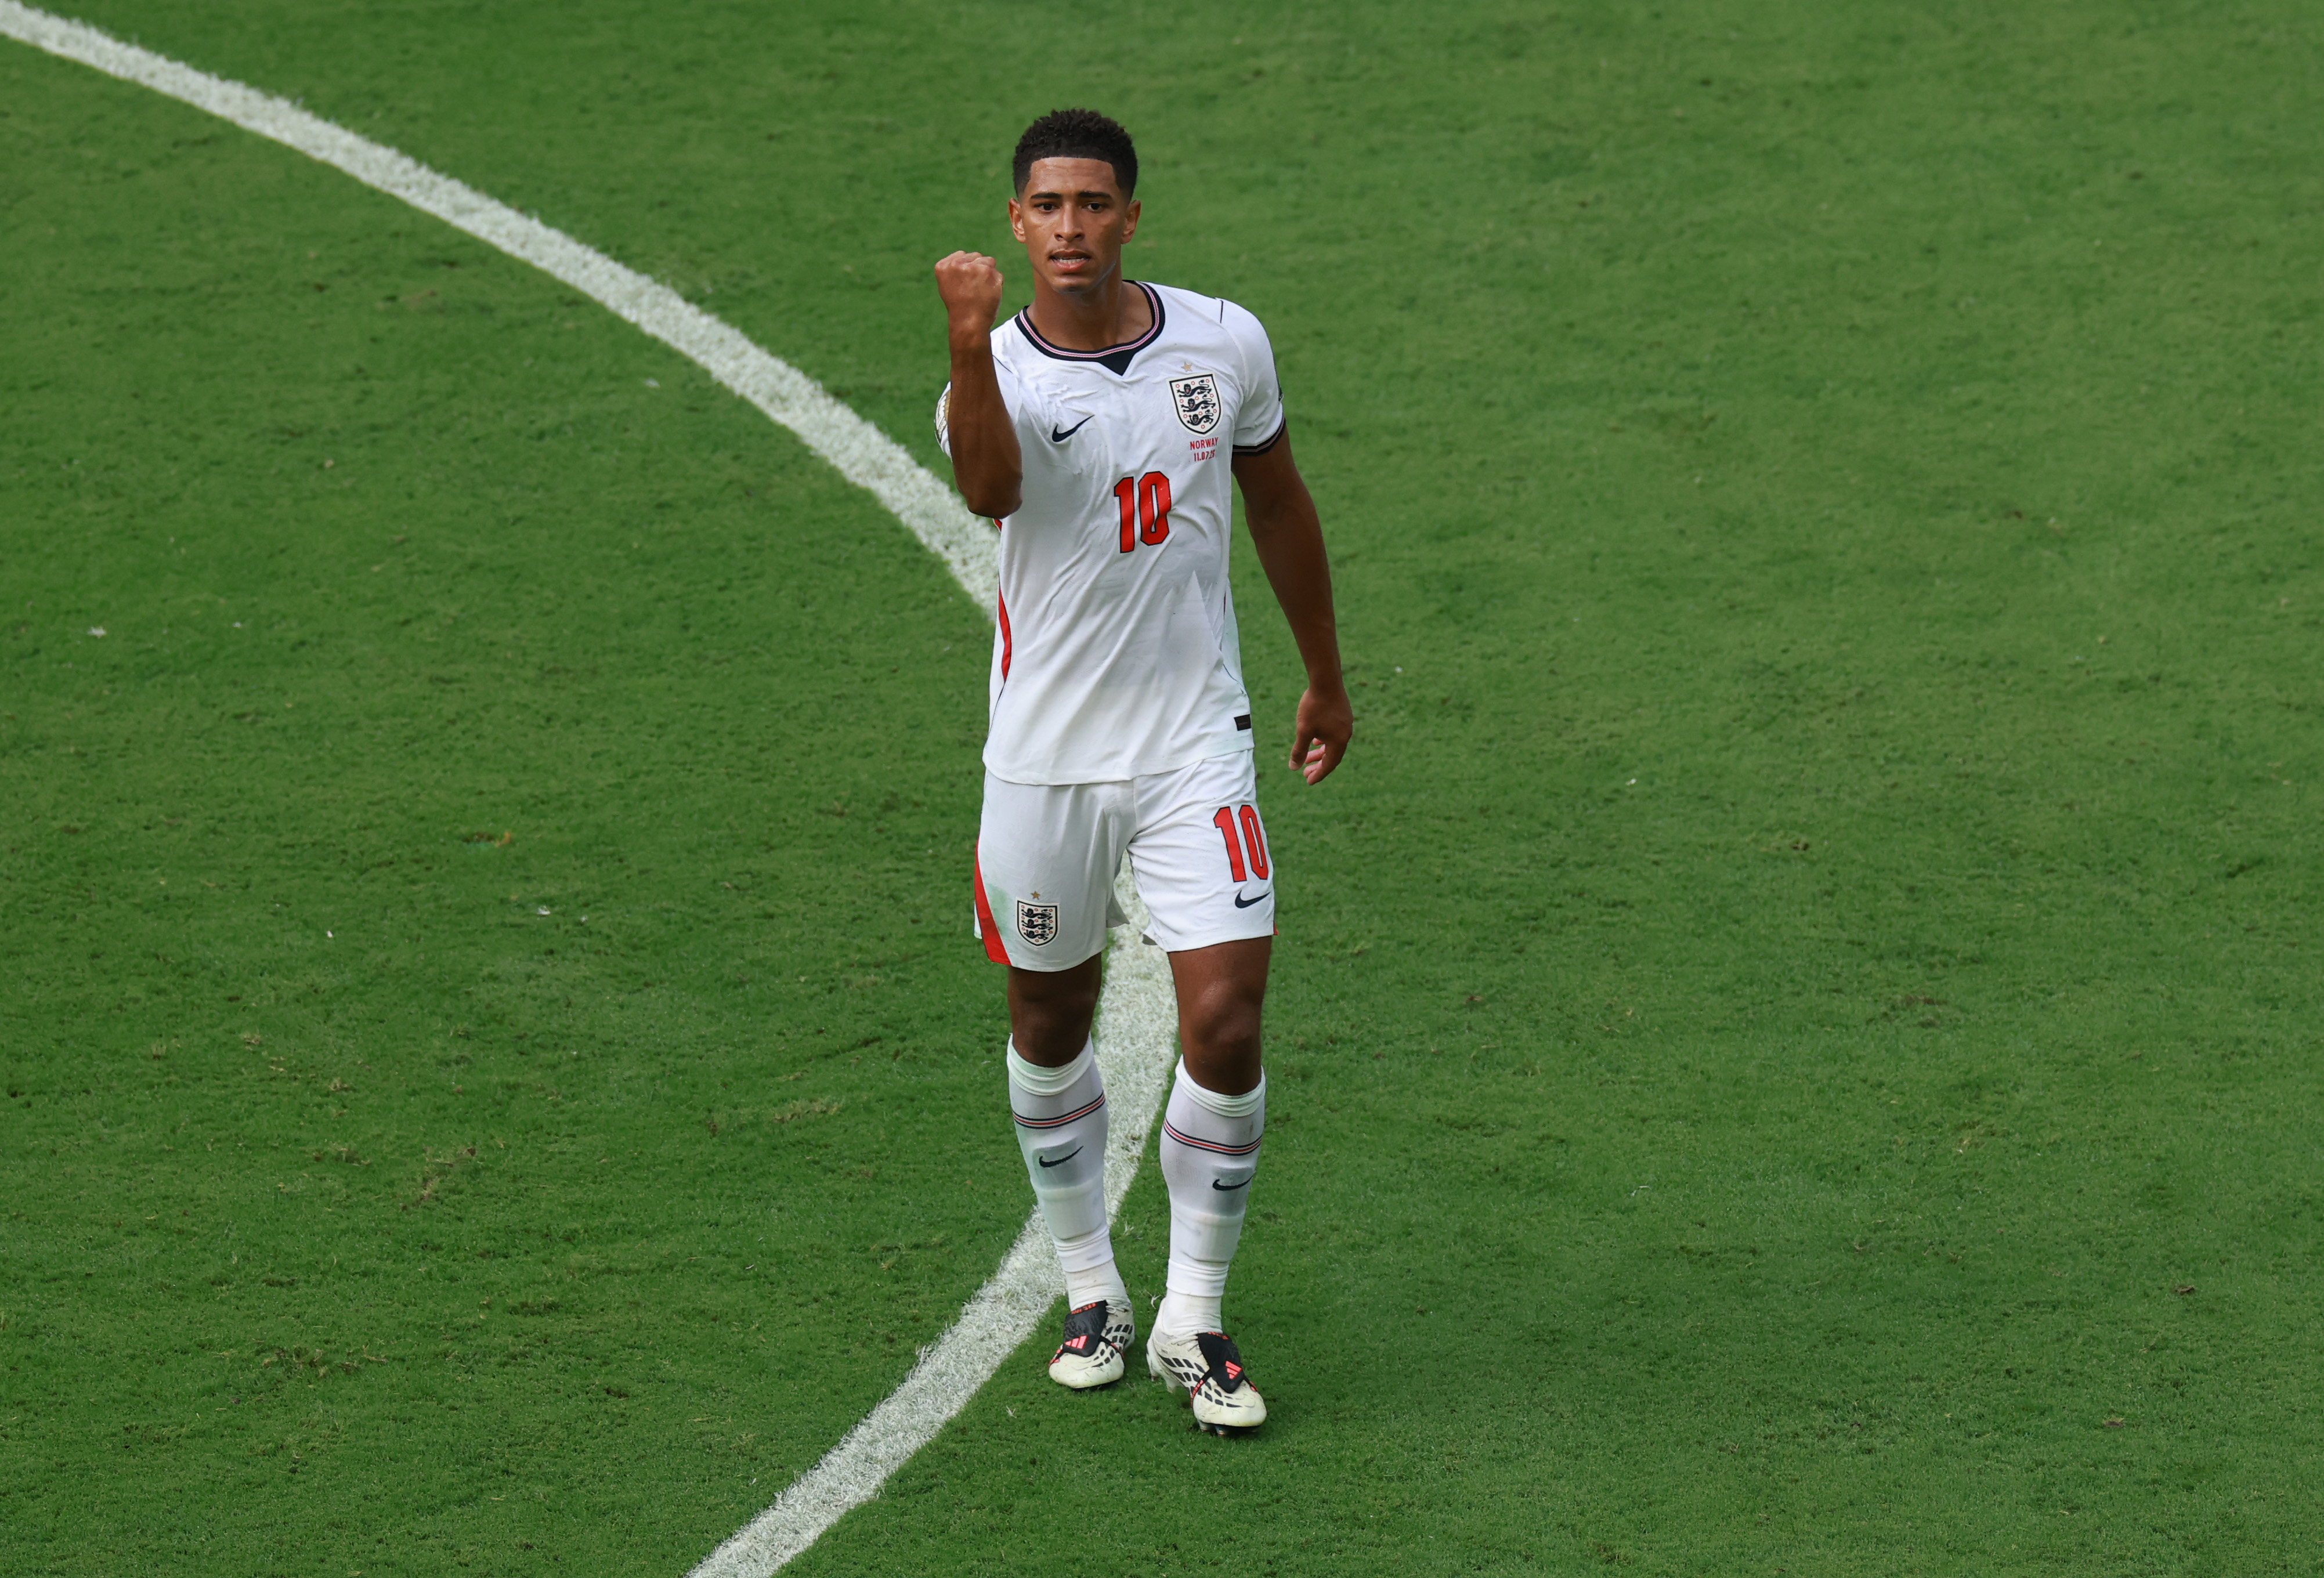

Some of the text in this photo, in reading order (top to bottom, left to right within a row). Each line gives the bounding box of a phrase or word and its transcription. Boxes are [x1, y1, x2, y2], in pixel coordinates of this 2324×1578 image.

[1190, 437, 1219, 450] NORWAY
[1114, 470, 1172, 553] 10
[1213, 804, 1269, 883] 10
